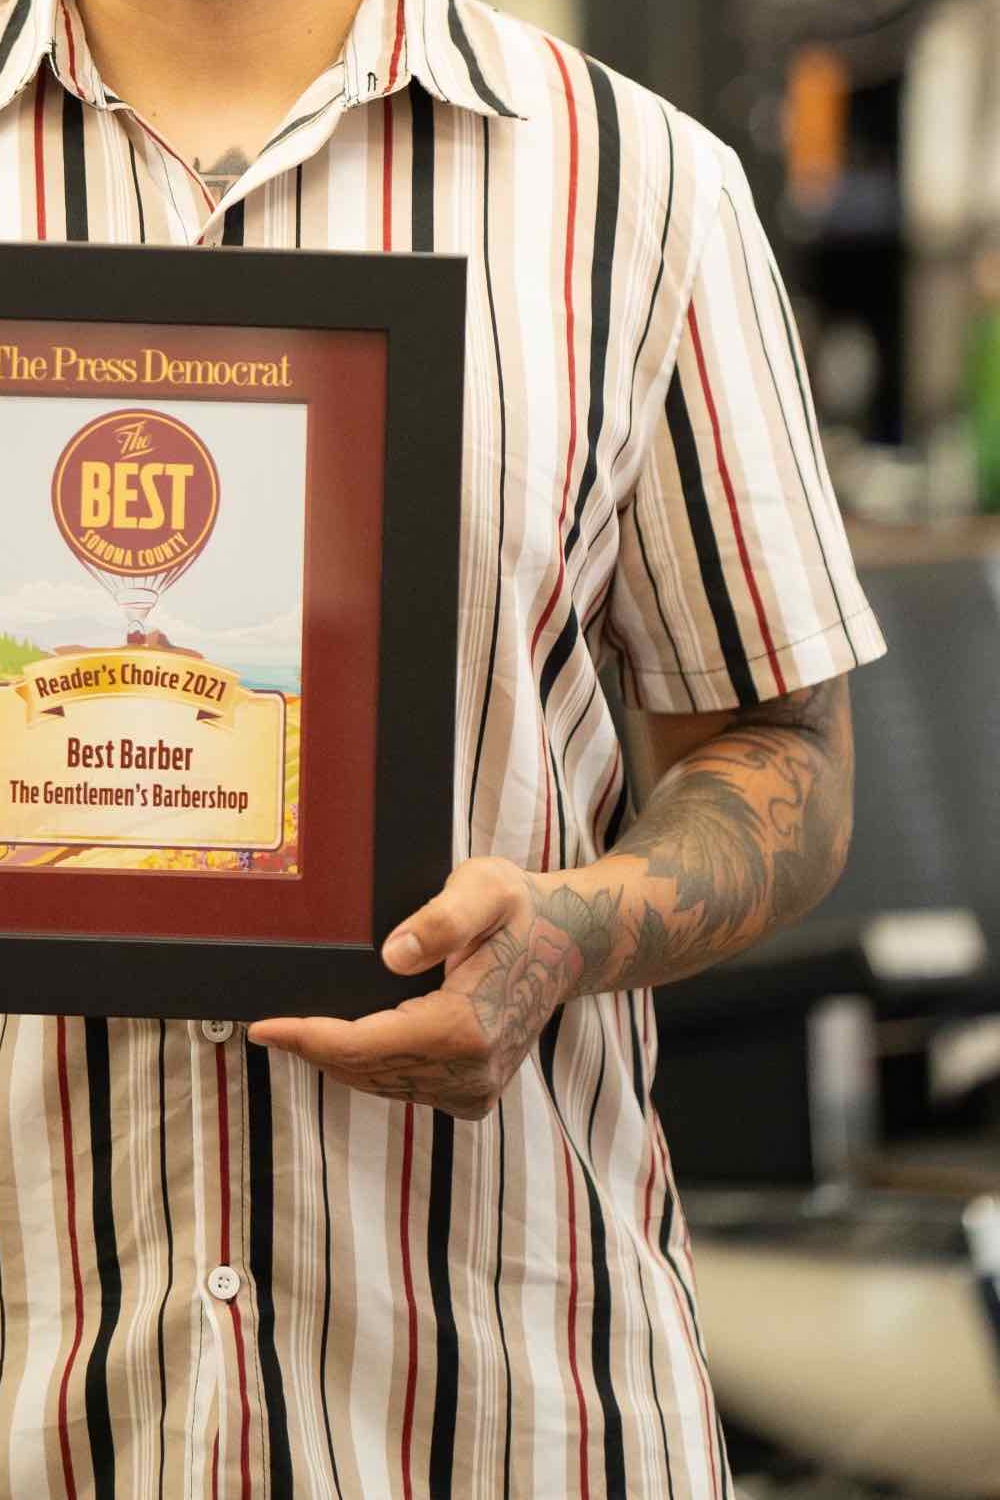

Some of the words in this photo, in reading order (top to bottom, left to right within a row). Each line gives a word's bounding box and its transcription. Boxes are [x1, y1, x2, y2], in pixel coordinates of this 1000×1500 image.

[51, 346, 137, 383] Press
[141, 349, 292, 387] Democrat
[113, 420, 153, 459] The
[80, 461, 194, 530] BEST
[80, 529, 133, 567] SONOMA
[137, 531, 189, 567] COUNTY
[35, 665, 116, 698] Reader's
[121, 664, 179, 690] Choice
[182, 671, 227, 701] 2021
[67, 737, 114, 769] Best
[120, 739, 193, 771] Barber
[10, 780, 39, 804] The
[43, 781, 147, 807] Gentlemen's
[152, 784, 249, 813] Barbershop
